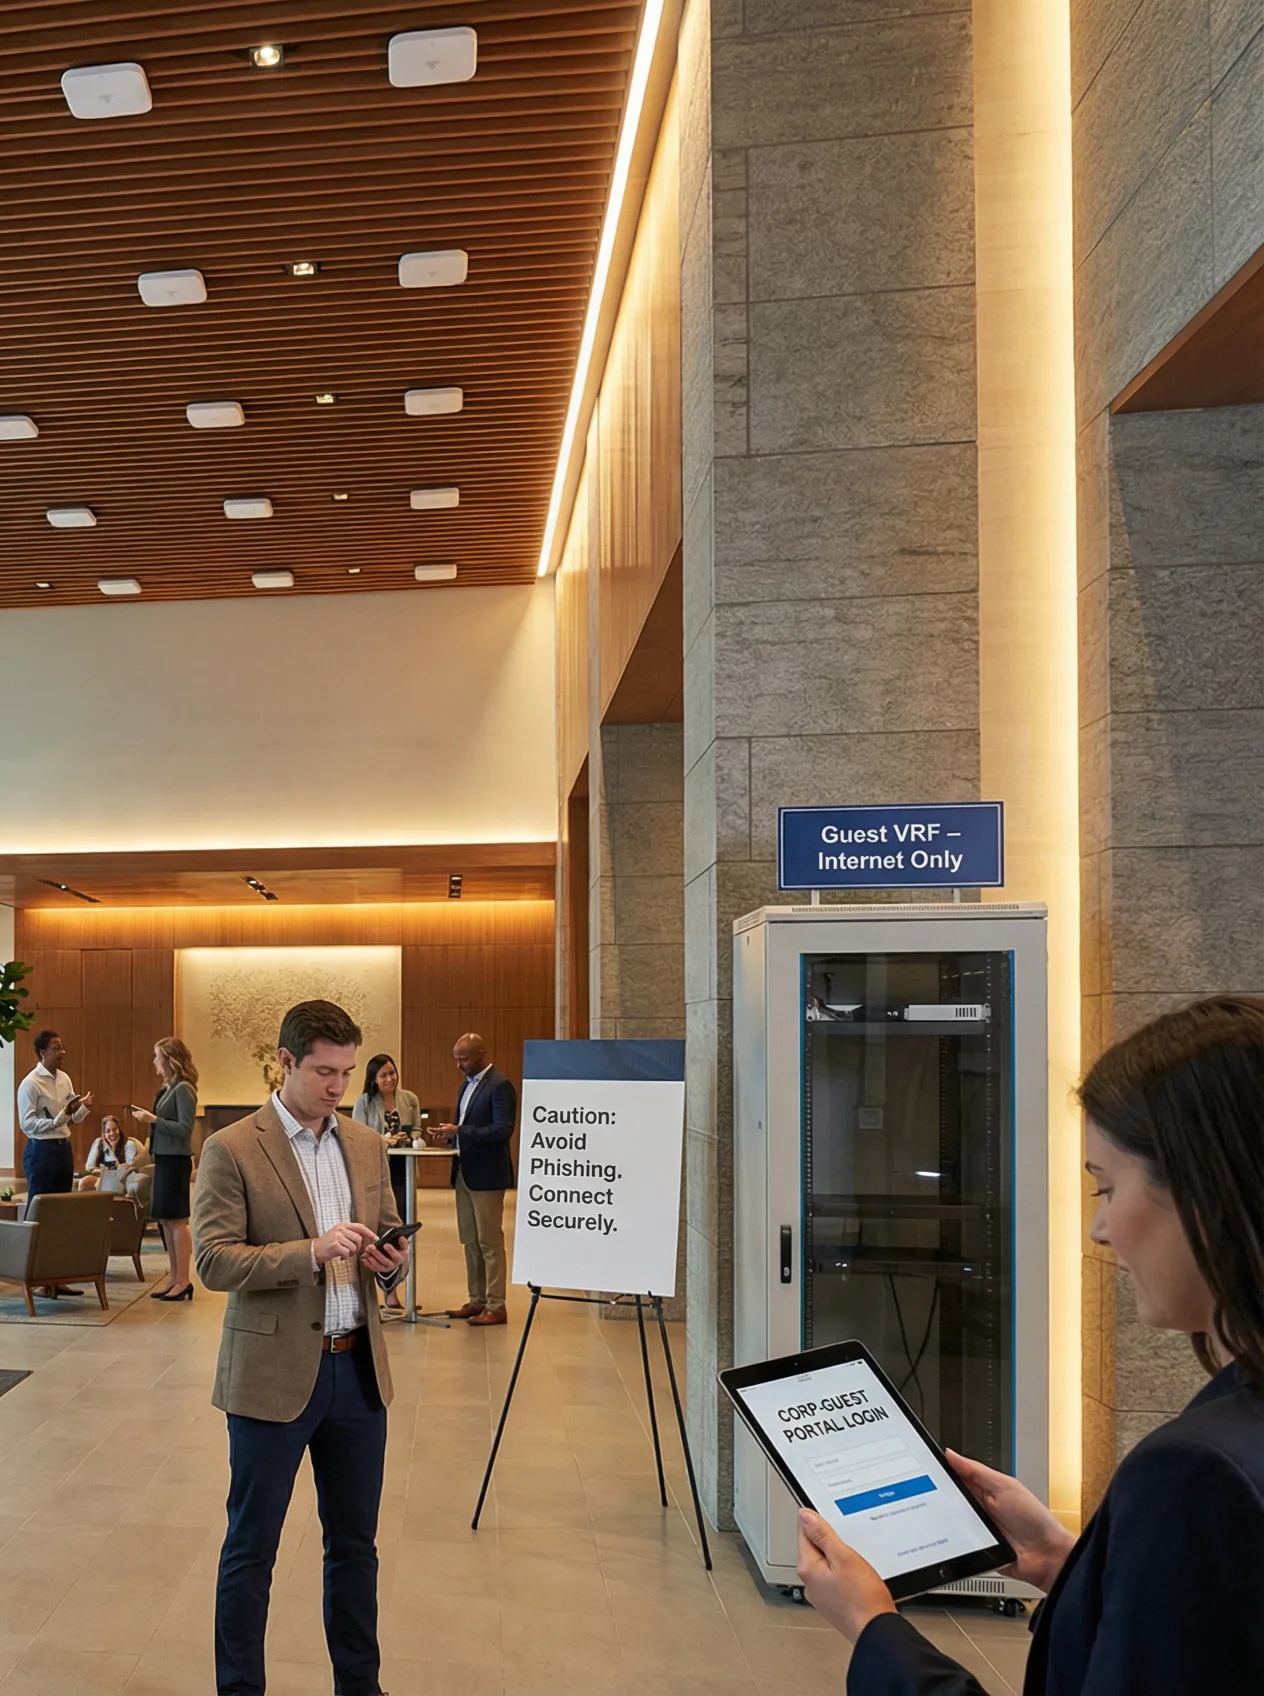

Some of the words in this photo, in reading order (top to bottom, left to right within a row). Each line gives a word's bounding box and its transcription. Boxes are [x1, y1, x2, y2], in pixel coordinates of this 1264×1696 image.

[821, 825, 888, 844] Guest
[893, 823, 941, 843] VRF
[818, 850, 905, 870] Internet
[910, 849, 964, 873] Only
[532, 1105, 616, 1125] Caution:
[530, 1131, 587, 1151] Avoid
[530, 1157, 622, 1183] Phishing.
[528, 1184, 614, 1206] Connect
[527, 1209, 618, 1236] Securely.
[777, 1389, 869, 1423] CORP-GUEST
[782, 1418, 845, 1443] PORTAL
[842, 1406, 890, 1429] LOGIN
